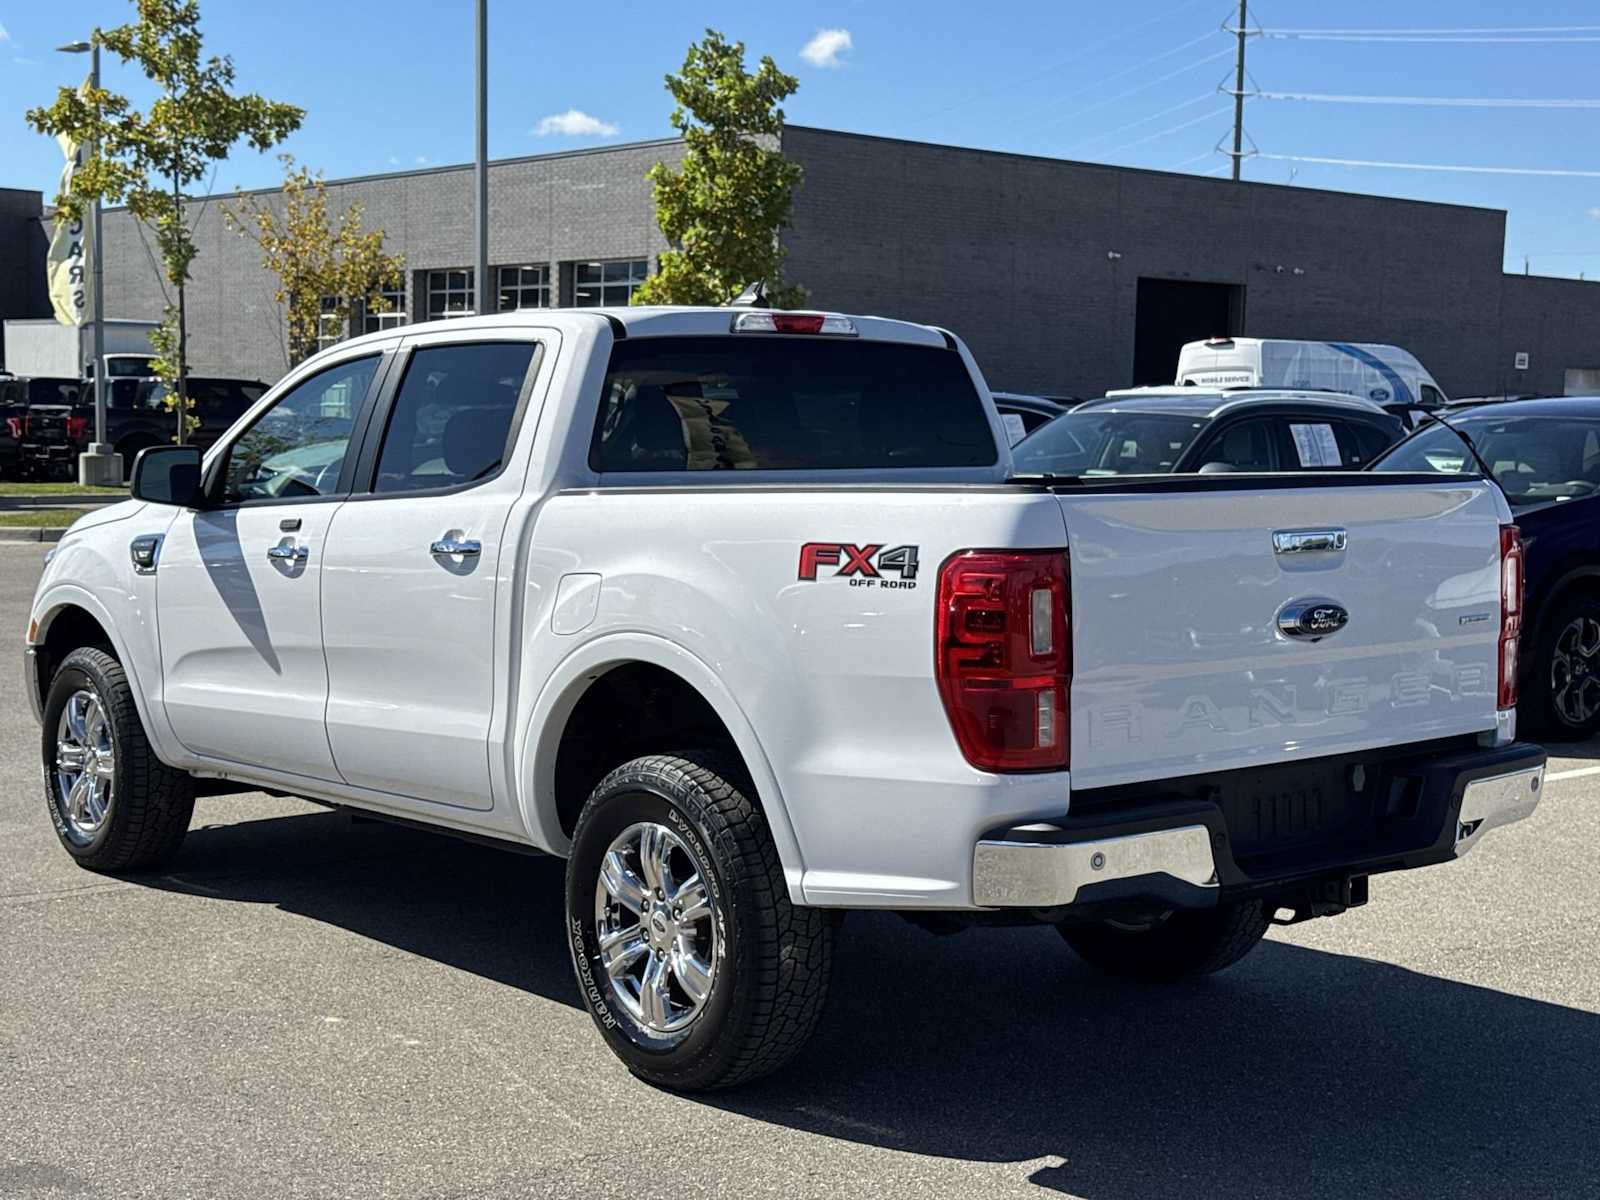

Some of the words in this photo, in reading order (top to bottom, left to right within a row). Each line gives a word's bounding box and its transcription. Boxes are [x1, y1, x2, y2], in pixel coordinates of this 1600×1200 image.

[797, 542, 919, 582] FX4
[849, 579, 876, 588] OFF
[880, 580, 917, 590] ROAD
[1310, 608, 1339, 629] Ford
